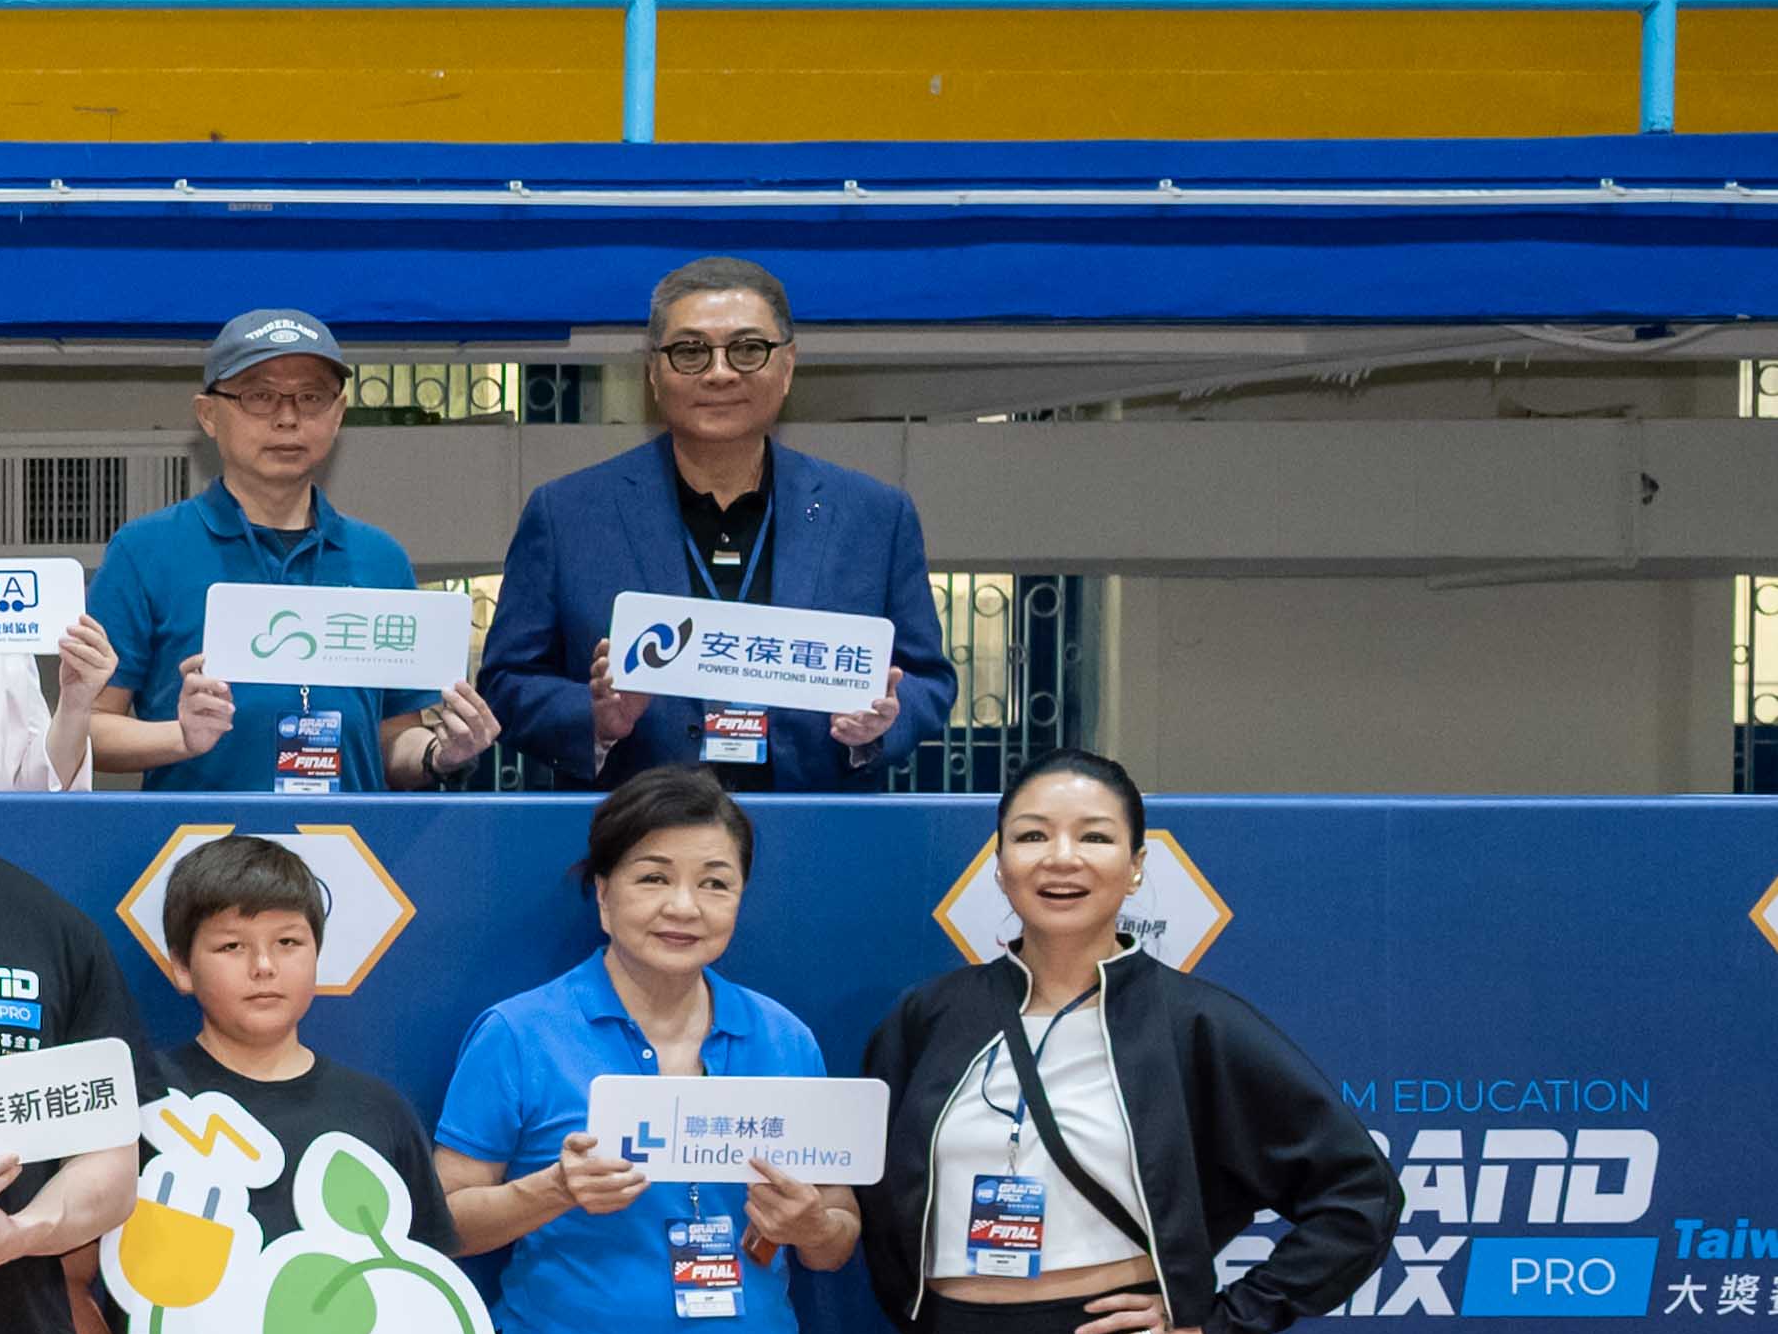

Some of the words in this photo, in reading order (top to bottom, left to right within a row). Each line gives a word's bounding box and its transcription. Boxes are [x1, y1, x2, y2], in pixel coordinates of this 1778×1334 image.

[700, 632, 873, 675] 安葆電能
[698, 663, 739, 677] POWER
[742, 668, 807, 683] SOLUTIONS
[809, 674, 870, 690] UNLIMITED
[715, 718, 763, 731] FINAL
[294, 756, 337, 768] FINAL
[1394, 1078, 1651, 1113] EDUCATION
[684, 1115, 785, 1140] 聯華林德
[682, 1142, 744, 1167] Linde
[751, 1142, 852, 1168] LienHwa
[1369, 1129, 1660, 1224] AND
[989, 1224, 1038, 1240] FINAL
[691, 1264, 736, 1279] FINAL
[1511, 1257, 1616, 1297] PRO
[1664, 1272, 1778, 1316] 大獎
